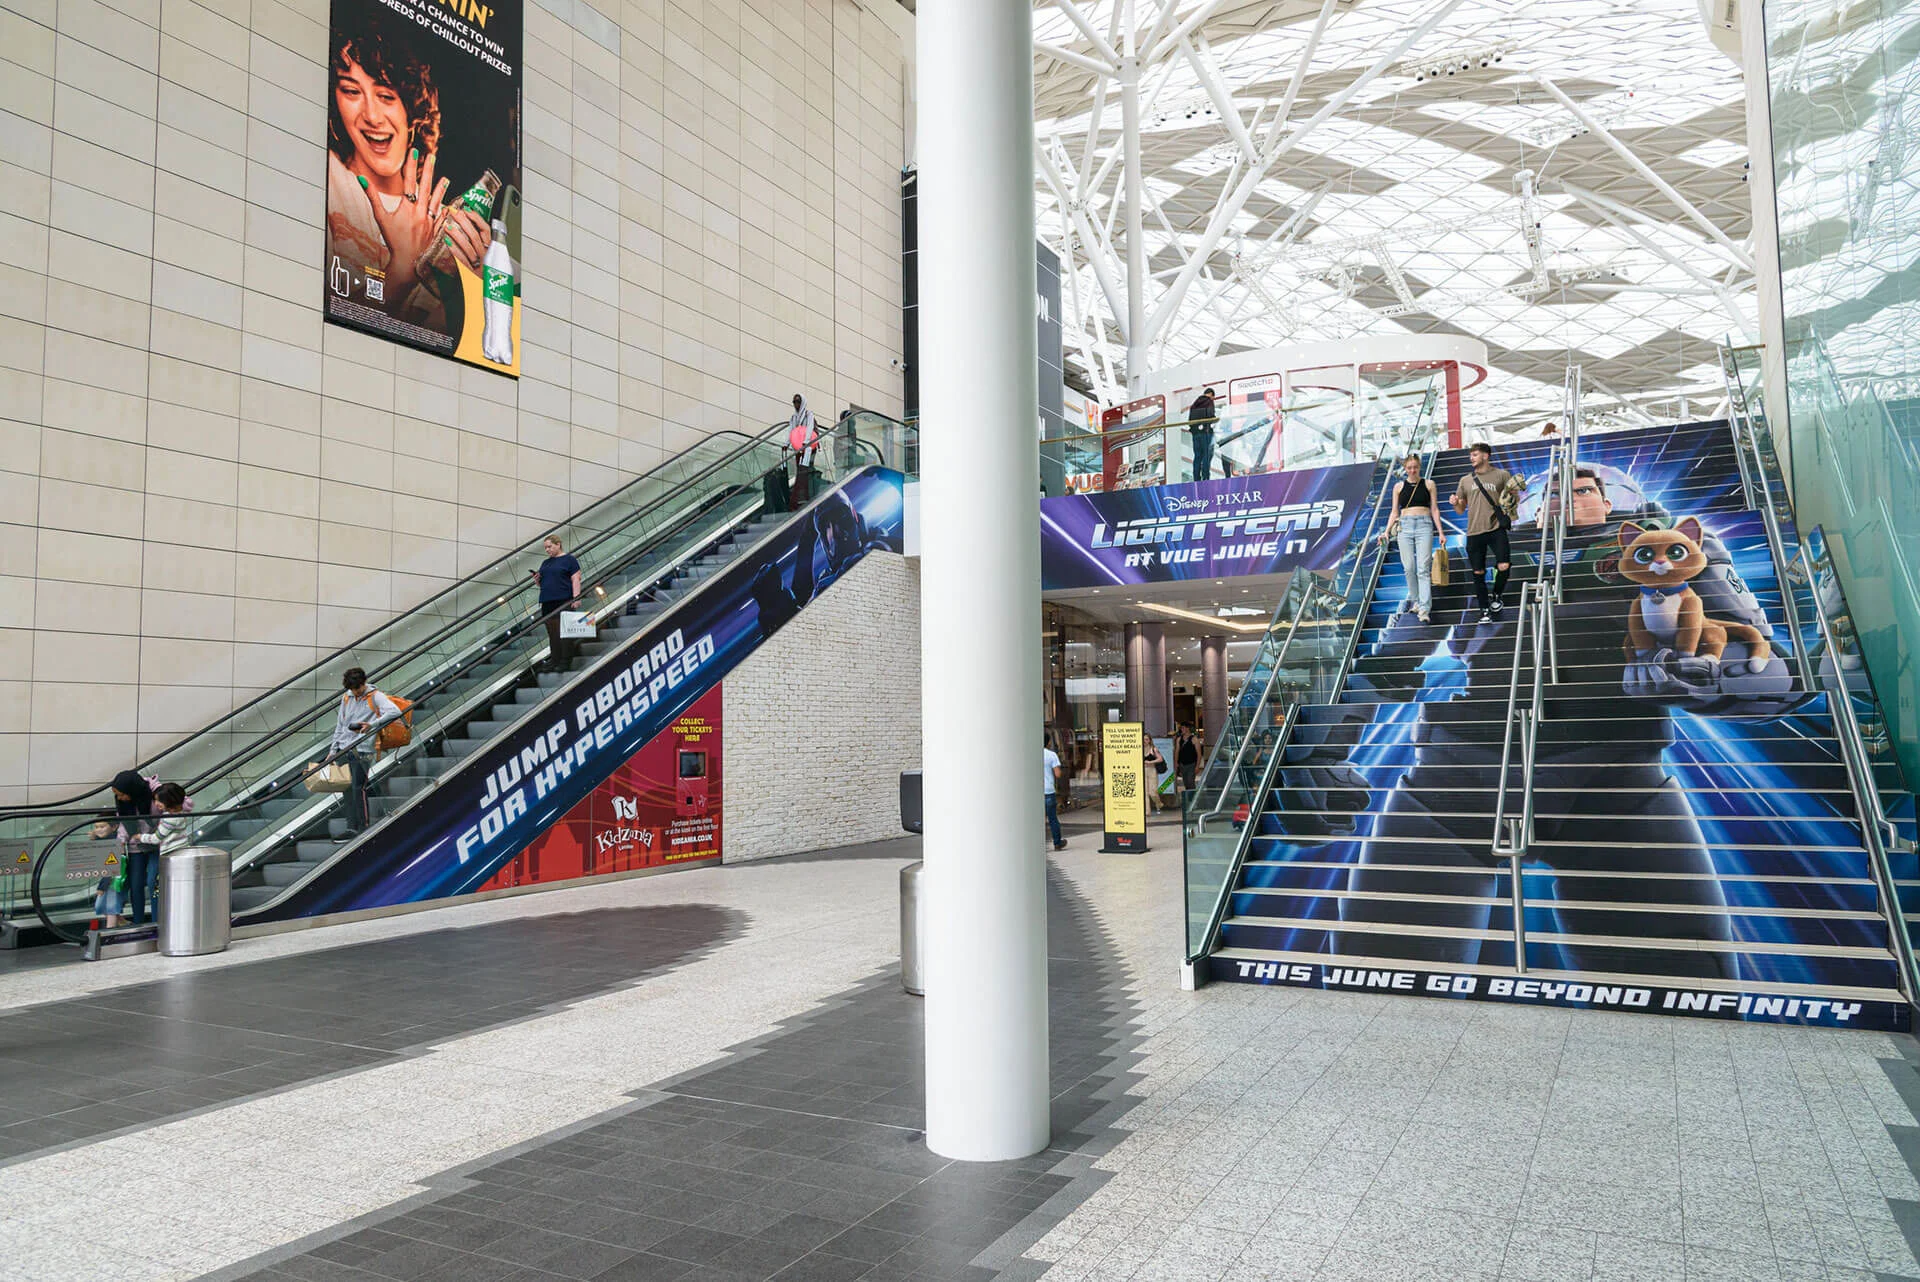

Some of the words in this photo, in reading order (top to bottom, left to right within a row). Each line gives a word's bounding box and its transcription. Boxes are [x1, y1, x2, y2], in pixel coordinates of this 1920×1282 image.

[416, 13, 432, 29] OF
[431, 23, 481, 57] CHILLOUT
[480, 51, 513, 76] PRIZES
[418, 0, 427, 11] A
[427, 5, 469, 36] CHANCE
[469, 28, 484, 44] TO
[484, 38, 505, 57] WIN
[1163, 496, 1210, 513] Disney
[1216, 490, 1264, 505] PIXAR
[1125, 552, 1152, 567] AT
[1161, 547, 1205, 564] VUE
[1213, 543, 1277, 561] JUNE
[1285, 539, 1308, 554] 17
[480, 719, 567, 809] JUMP
[575, 628, 684, 730] ABOARD
[672, 726, 688, 734] YOUR
[456, 788, 528, 865] FOR
[534, 633, 715, 800] HYPERSPEED
[1235, 961, 1312, 982] THIS
[1322, 967, 1415, 990] JUNE
[1425, 973, 1477, 993] GO
[1488, 977, 1651, 1007] BEYOND
[1662, 989, 1863, 1021] INFINITY
